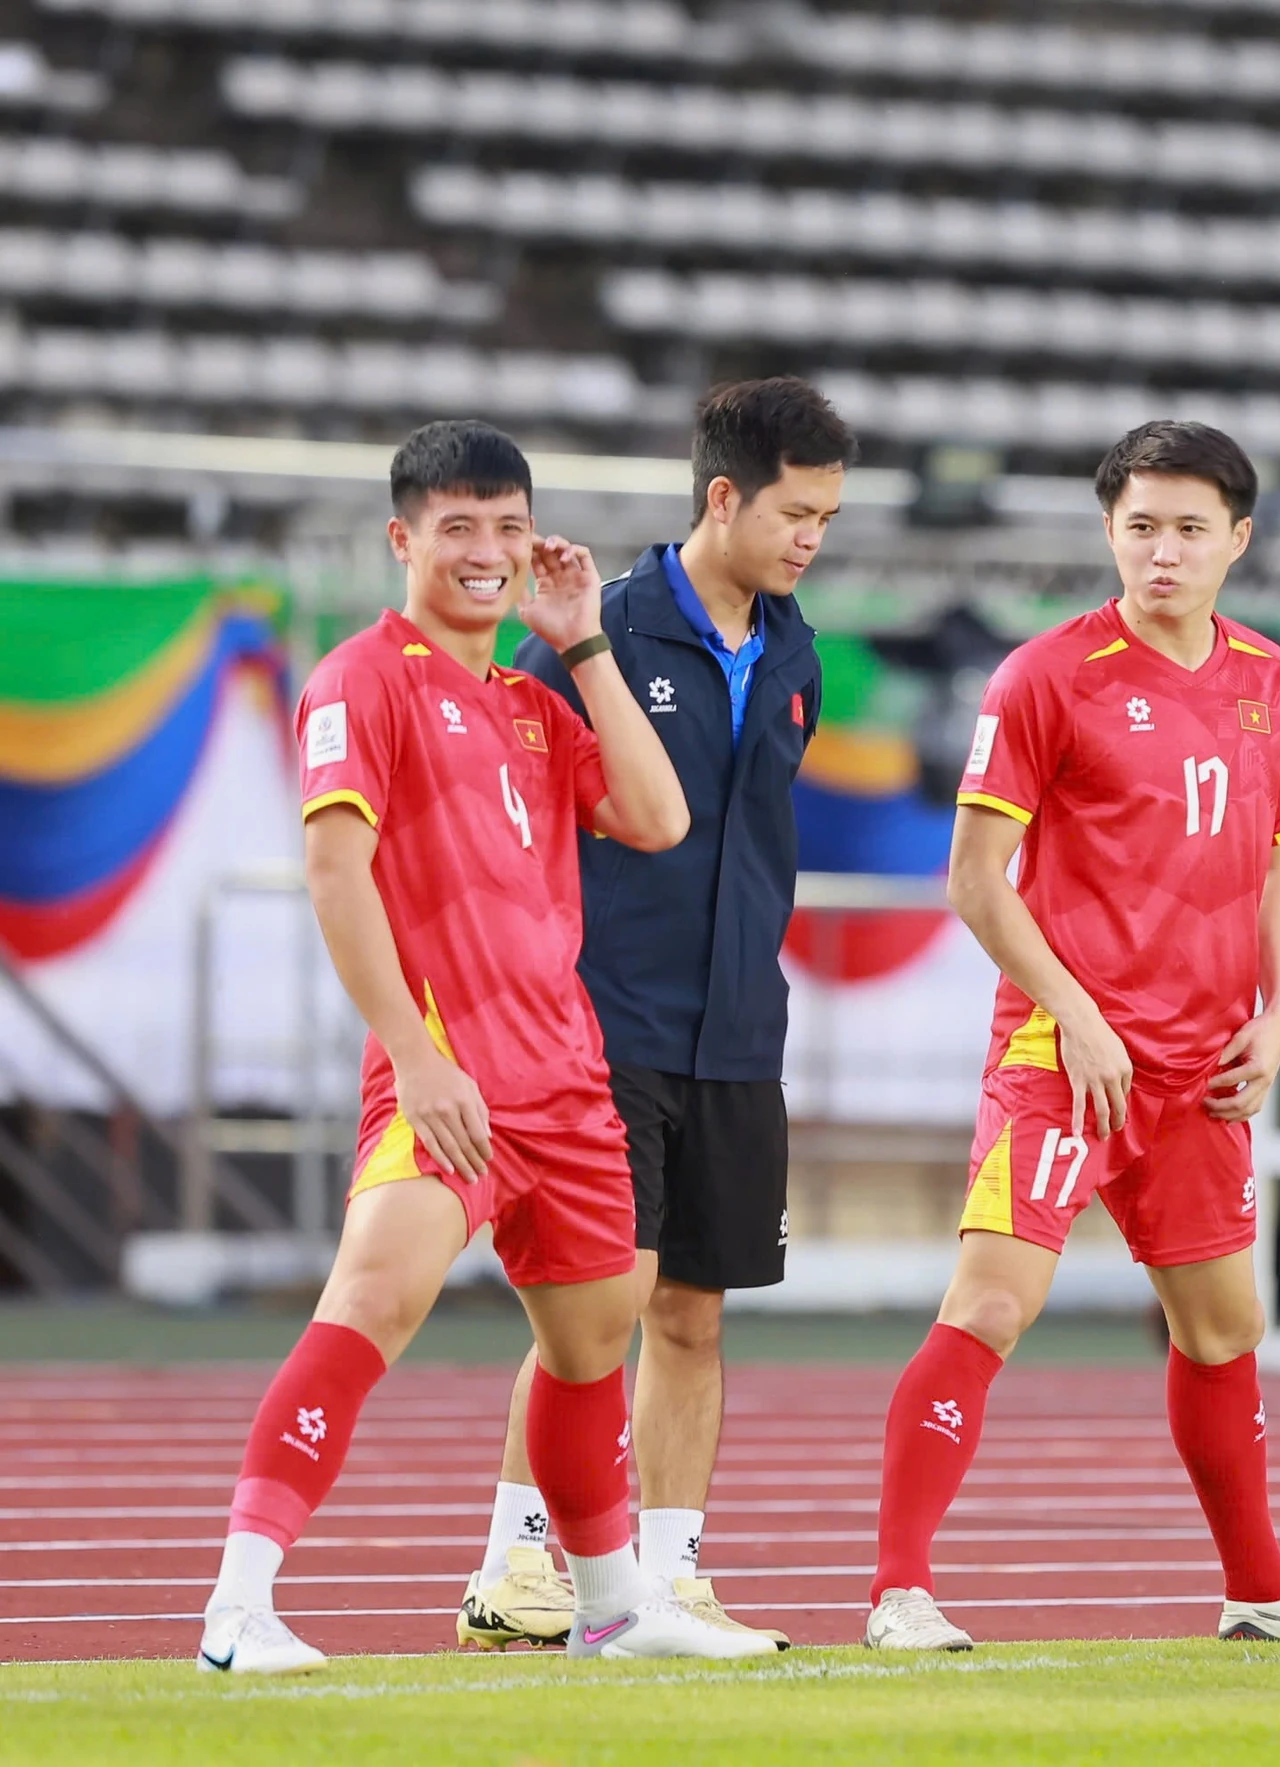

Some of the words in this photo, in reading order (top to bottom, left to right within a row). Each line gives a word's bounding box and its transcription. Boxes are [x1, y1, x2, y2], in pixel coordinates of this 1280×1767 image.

[499, 763, 533, 849] 4
[1183, 755, 1230, 838] 17
[1029, 1128, 1089, 1208] 17
